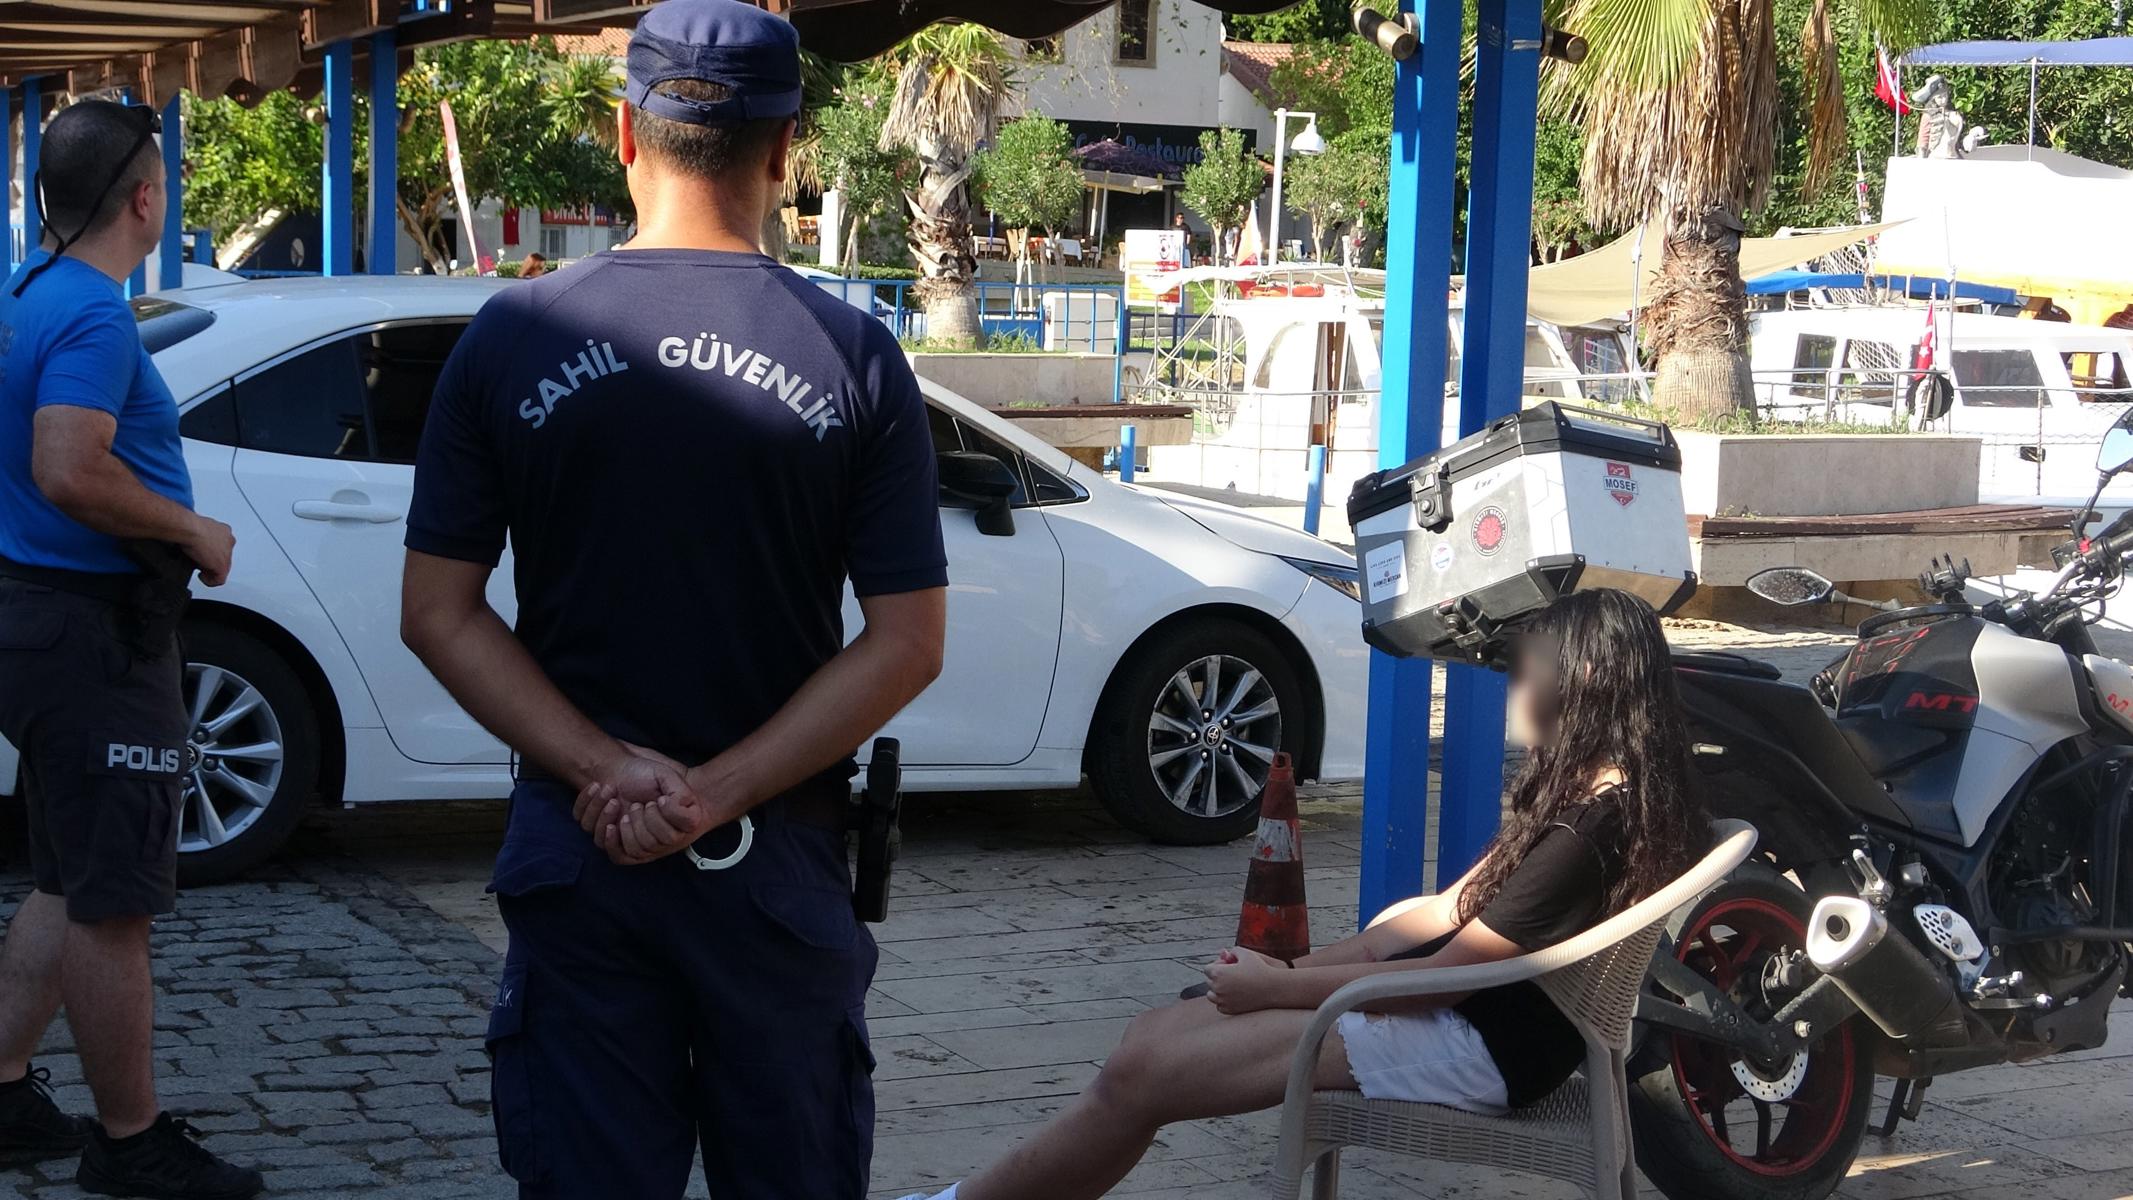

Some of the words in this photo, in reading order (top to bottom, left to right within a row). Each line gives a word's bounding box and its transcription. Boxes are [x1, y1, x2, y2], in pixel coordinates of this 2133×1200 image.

[1125, 135, 1205, 164] Restaura
[519, 338, 629, 430] SAHİL
[657, 331, 844, 443] GÜVENLİK
[1605, 478, 1636, 492] MOSEF
[1905, 692, 1979, 712] MT
